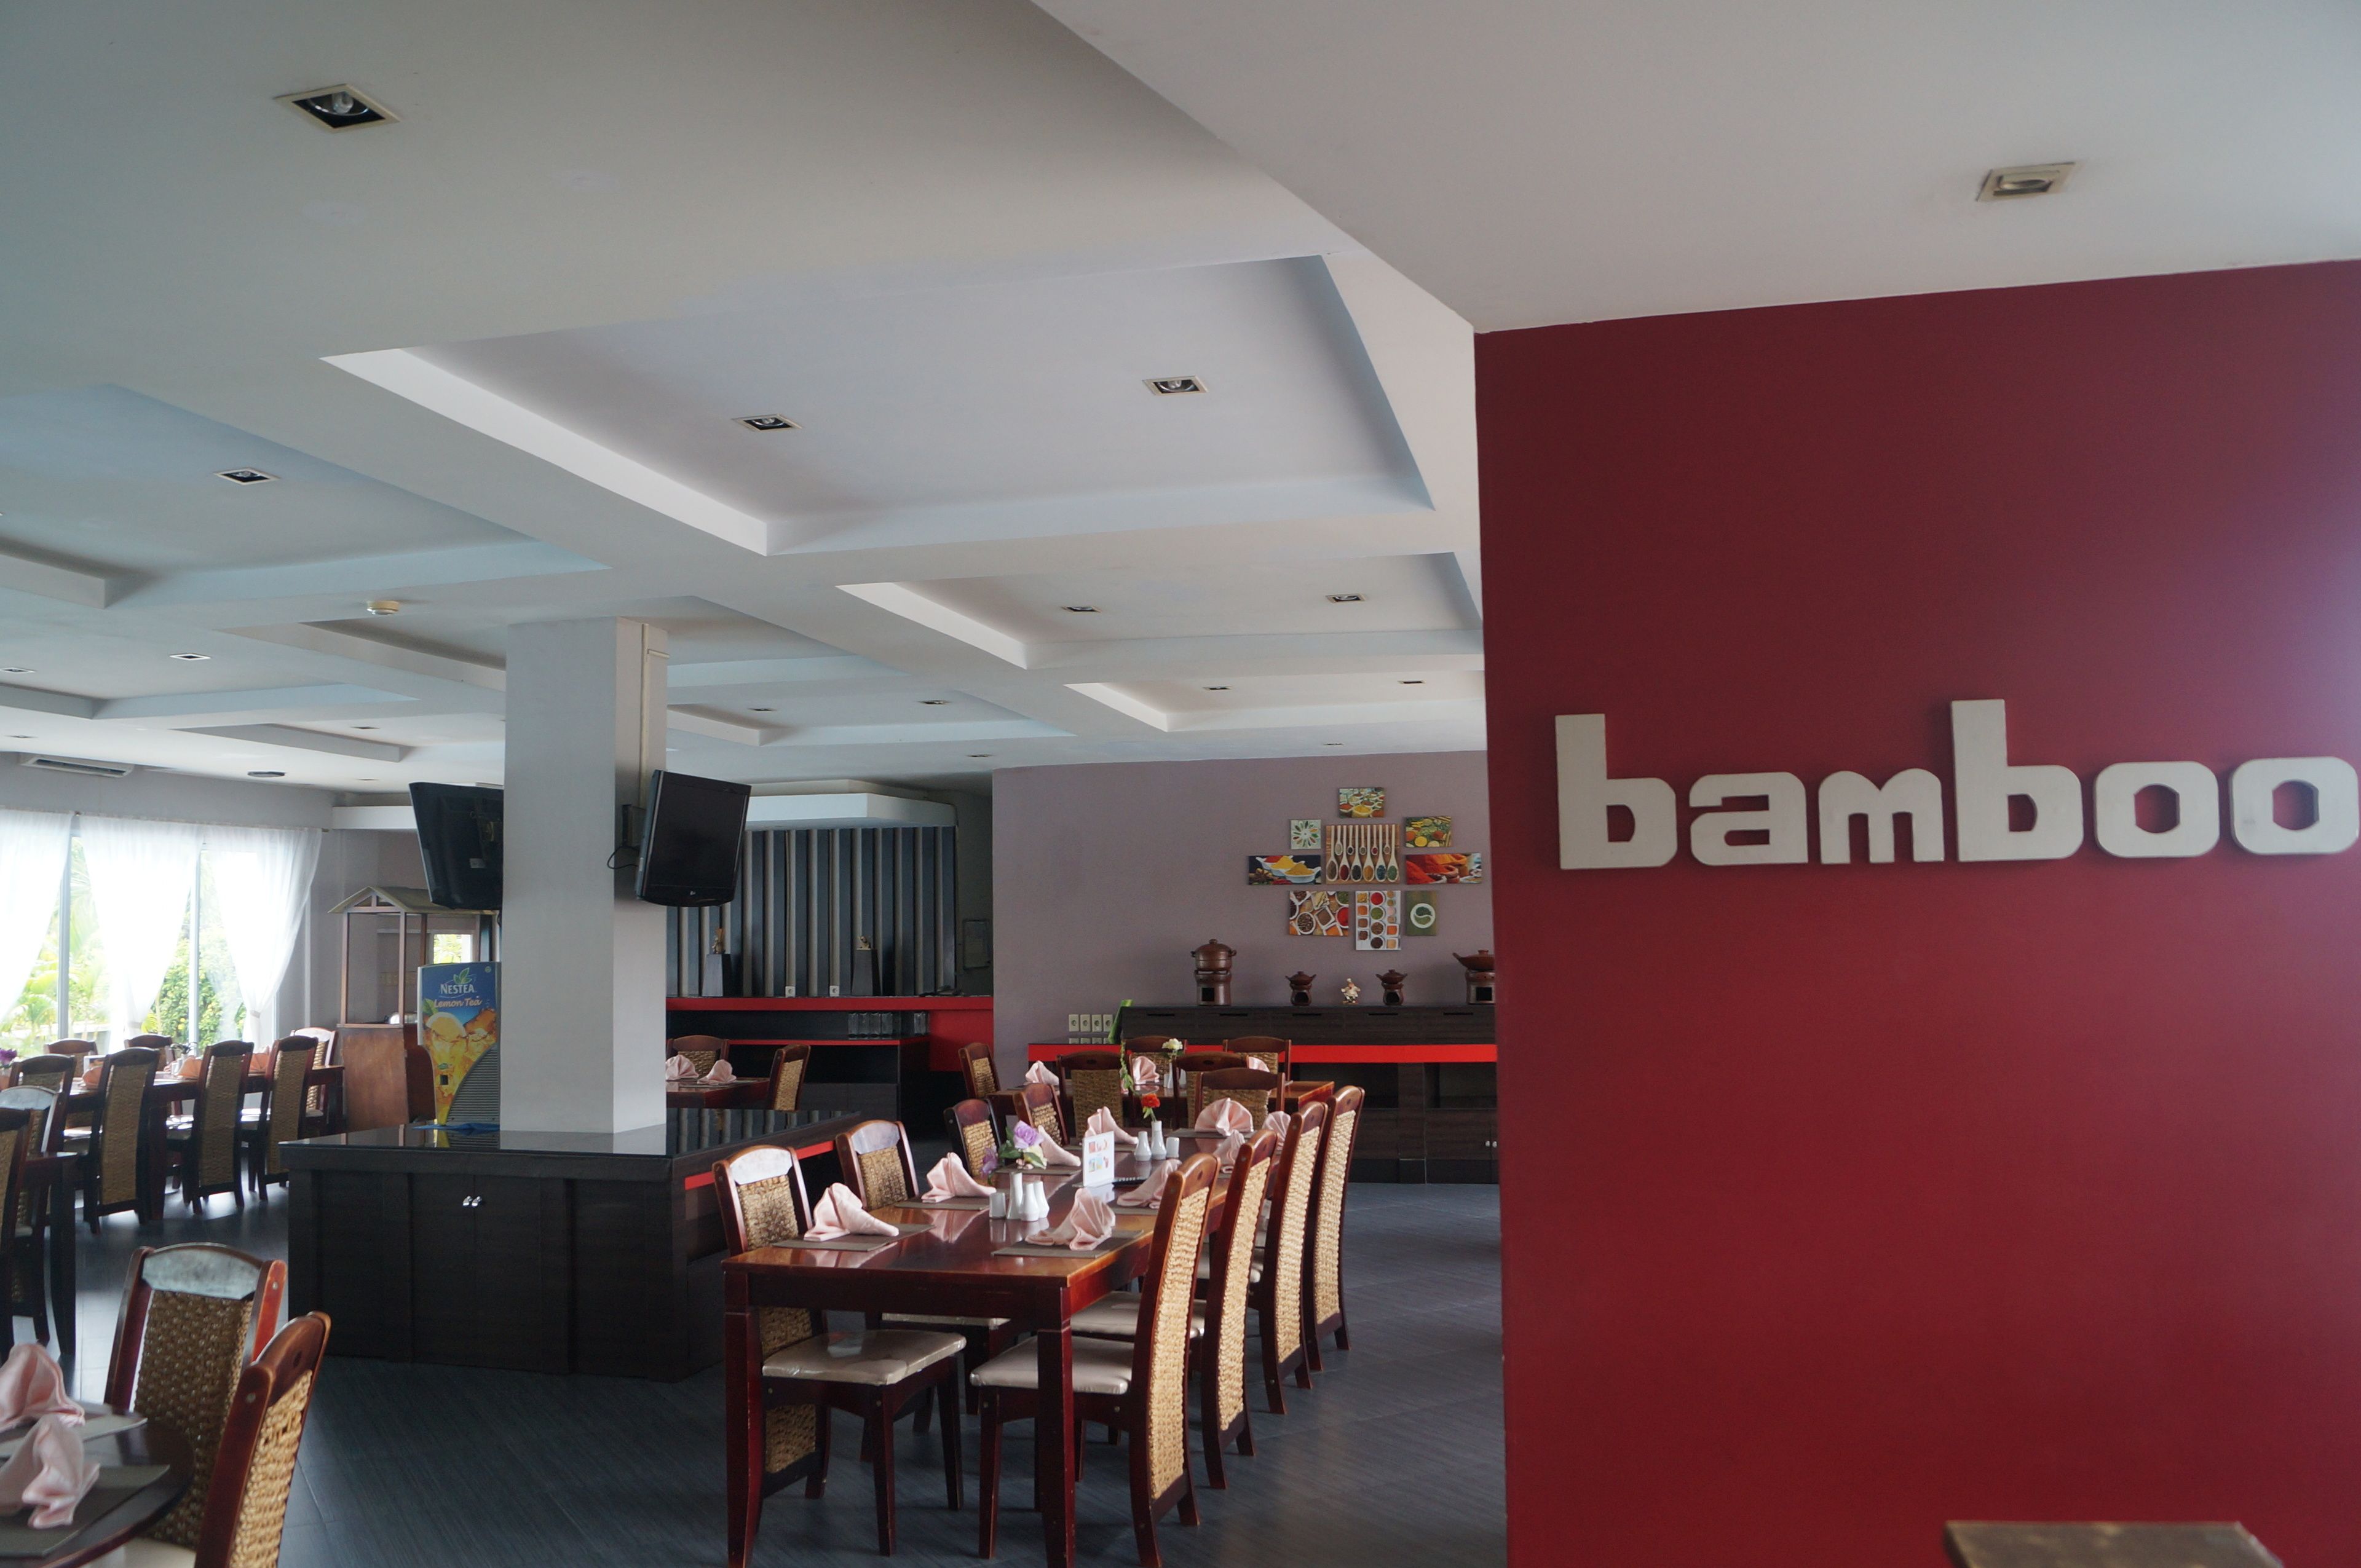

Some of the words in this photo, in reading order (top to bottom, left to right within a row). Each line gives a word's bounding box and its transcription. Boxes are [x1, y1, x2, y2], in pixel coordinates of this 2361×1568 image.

[1555, 699, 2360, 870] bamboo
[440, 984, 475, 994] NESTEA
[433, 999, 464, 1008] Lemon
[465, 997, 483, 1006] Tea
